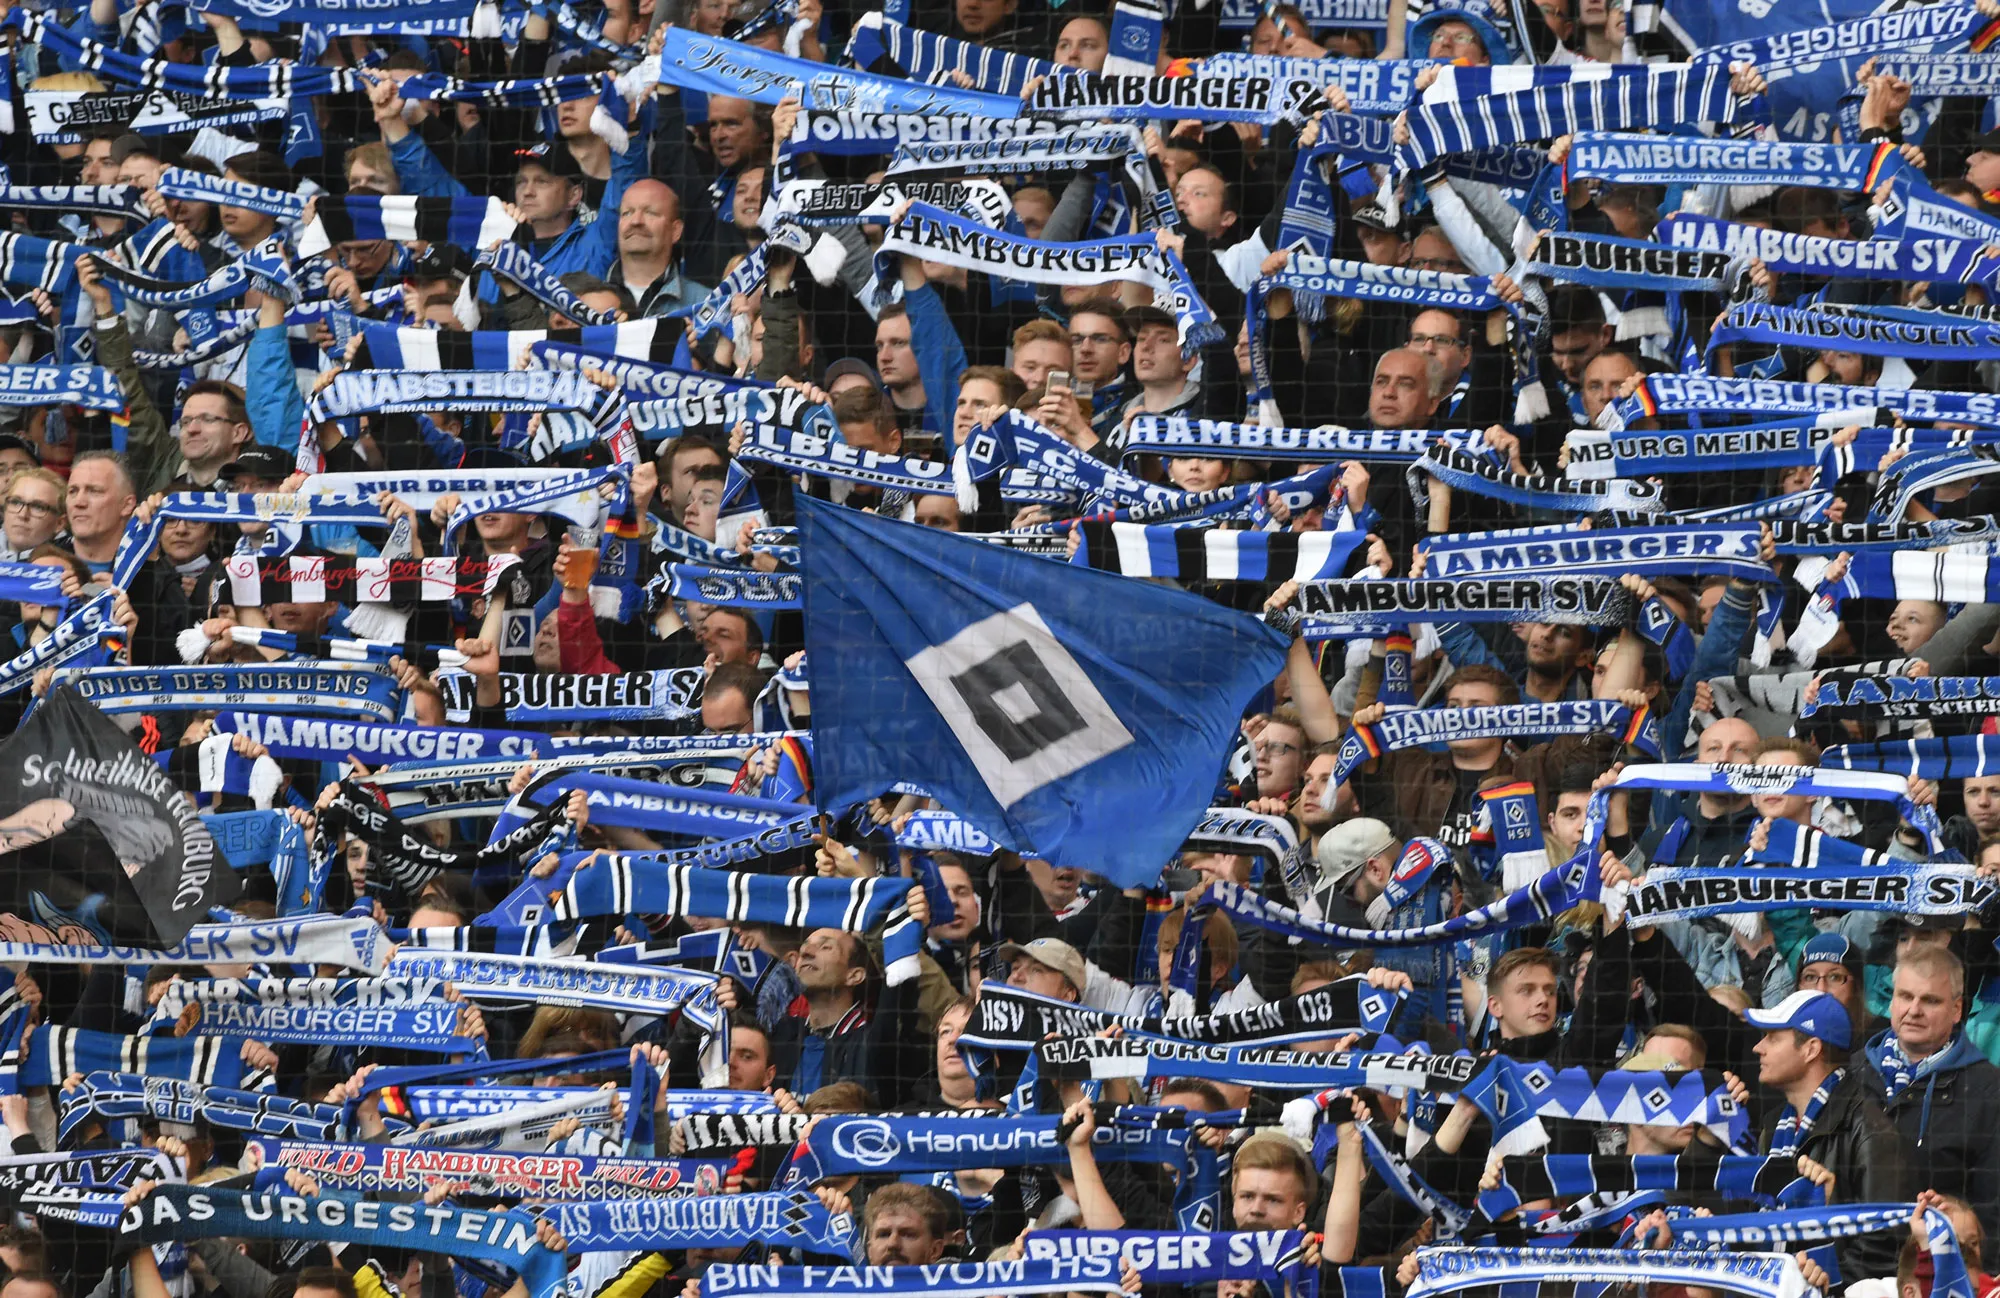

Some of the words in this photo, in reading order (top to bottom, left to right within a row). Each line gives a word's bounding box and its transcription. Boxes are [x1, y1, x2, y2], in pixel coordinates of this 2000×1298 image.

[1767, 7, 1979, 61] HAMBURGER
[1033, 72, 1272, 111] HAMBURGER
[1576, 145, 1793, 171] HAMBURGER
[1801, 146, 1862, 174] S.V.
[891, 214, 1154, 273] HAMBURGER
[1671, 221, 1901, 271] HAMBURGER
[1911, 238, 1964, 275] SV
[1354, 281, 1487, 307] 2000/2001
[447, 401, 500, 413] ZWEITE
[1129, 415, 1428, 453] HAMBURGER
[1694, 429, 1799, 457] MEINE
[426, 479, 488, 497] DER
[1551, 579, 1613, 616] SV
[174, 672, 227, 693] DES
[237, 672, 370, 696] NORDENS
[1380, 703, 1560, 742] HAMBURGER
[1572, 700, 1619, 727] S.V.
[1880, 703, 1919, 717] IST
[233, 711, 484, 762] HAMBURGER
[1926, 876, 1994, 906] SV
[250, 922, 301, 957] SV
[203, 1004, 393, 1033] HAMBURGER
[412, 1010, 454, 1034] S.V.
[980, 998, 1025, 1032] HSV
[1296, 989, 1333, 1024] 08
[200, 1027, 268, 1038] DEUTSCHER
[1042, 1036, 1229, 1064] HAMBURG
[1237, 1046, 1352, 1069] MEINE
[1359, 1052, 1477, 1082] PERLE
[277, 1148, 366, 1177] WORLD
[382, 1147, 583, 1189] HAMBURGER
[593, 1163, 682, 1191] WORLD
[121, 1194, 216, 1234] DAS
[241, 1192, 540, 1256] URGESTEIN
[559, 1203, 591, 1237] SV
[605, 1195, 781, 1233] HAMBURGER
[1229, 1230, 1288, 1267] SV
[707, 1263, 780, 1294] BIN
[803, 1264, 894, 1288] FAN
[918, 1257, 1024, 1287] VOM
[1051, 1255, 1113, 1280] HS
